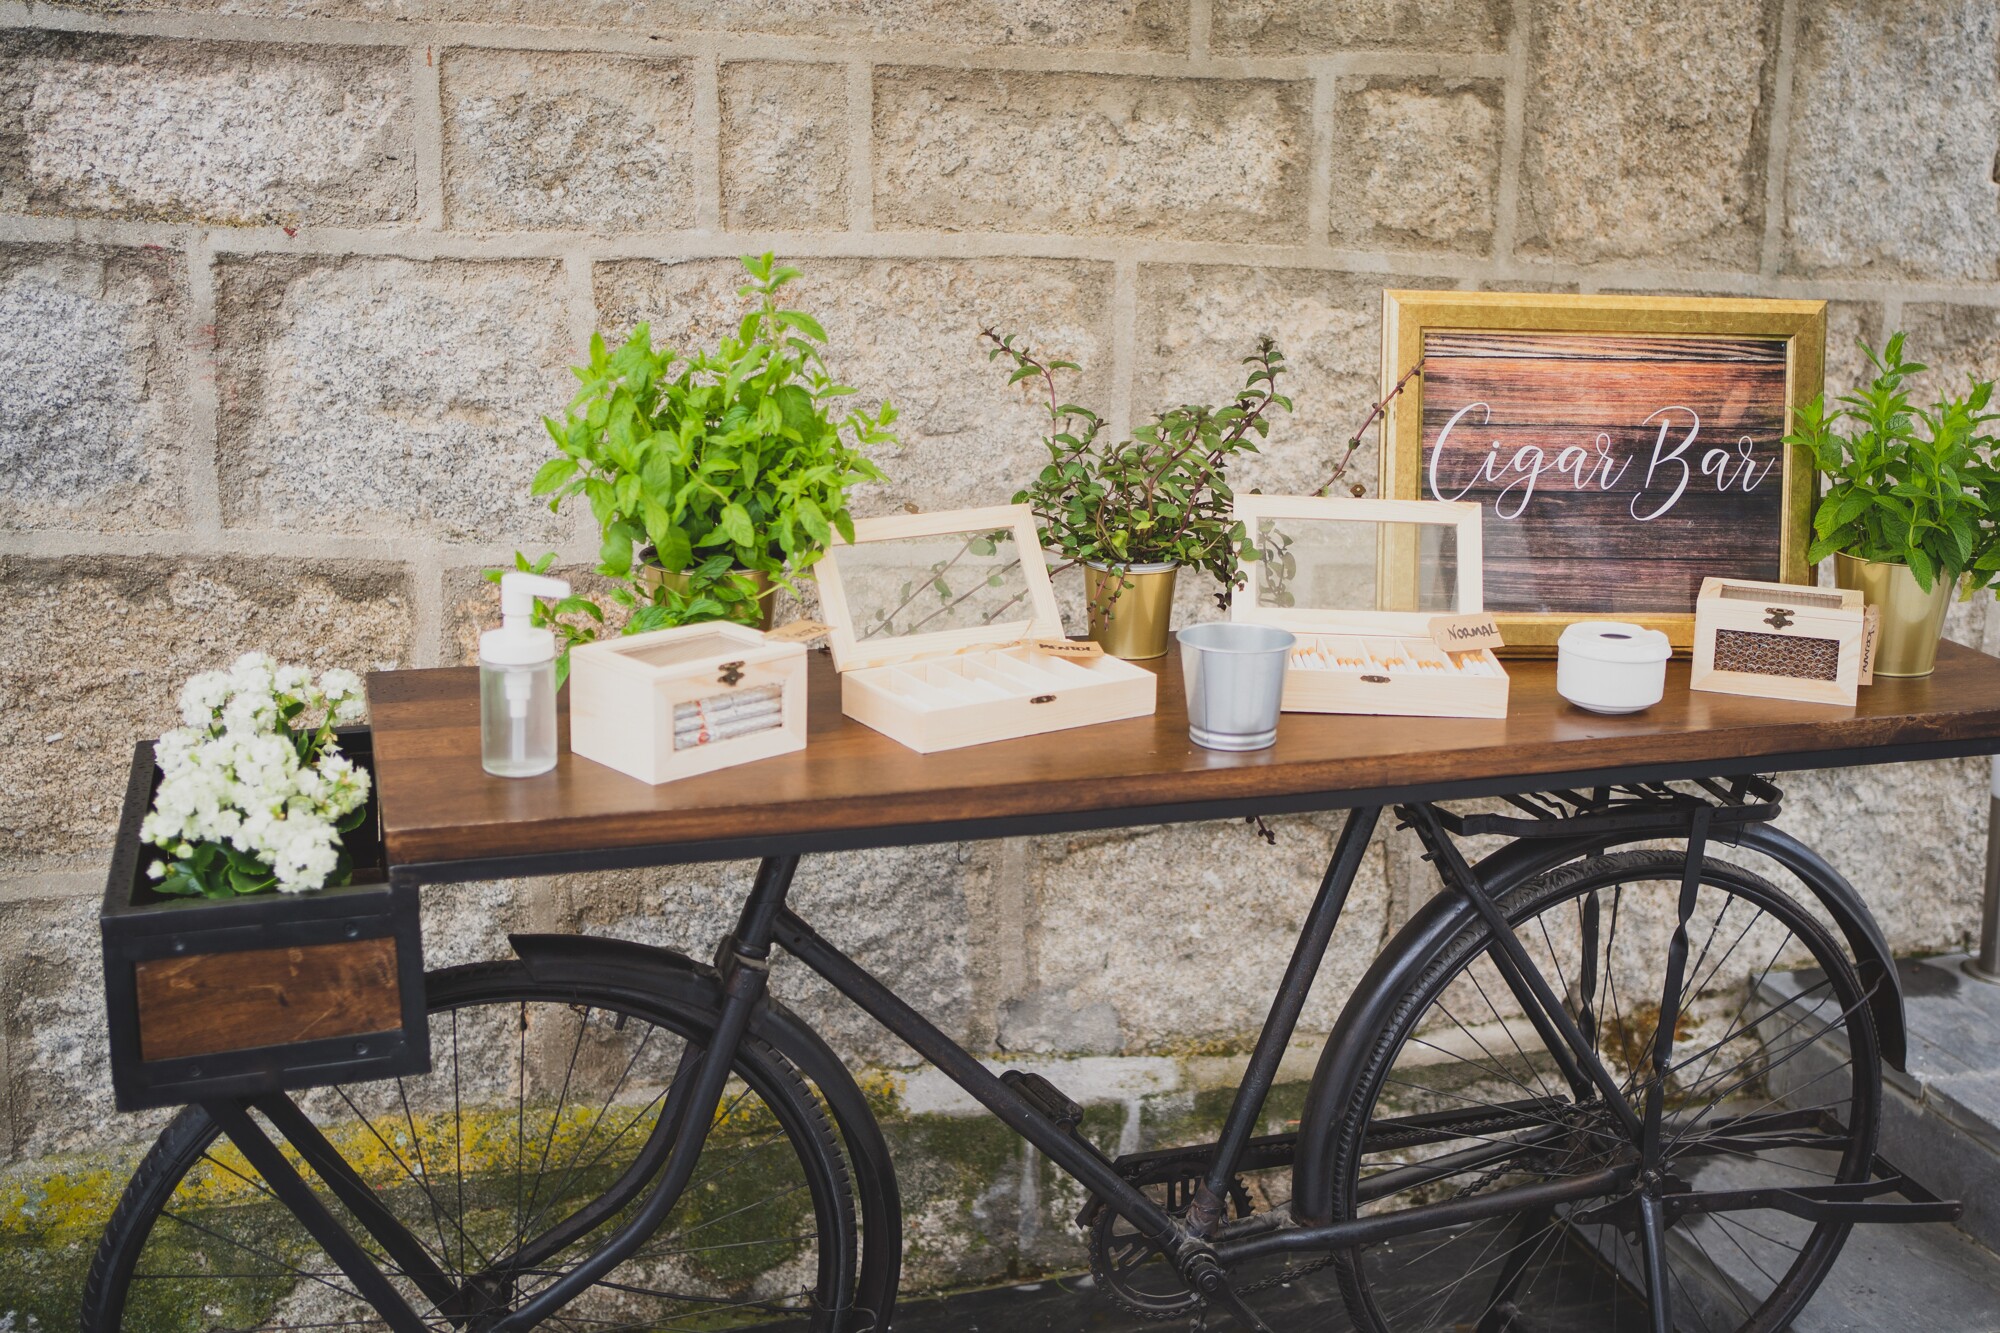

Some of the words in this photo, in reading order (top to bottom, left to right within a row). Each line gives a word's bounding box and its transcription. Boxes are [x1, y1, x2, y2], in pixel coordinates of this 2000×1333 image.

[1429, 402, 1632, 520] Cigar
[1630, 405, 1775, 521] Bar
[1447, 623, 1498, 641] NORMAL
